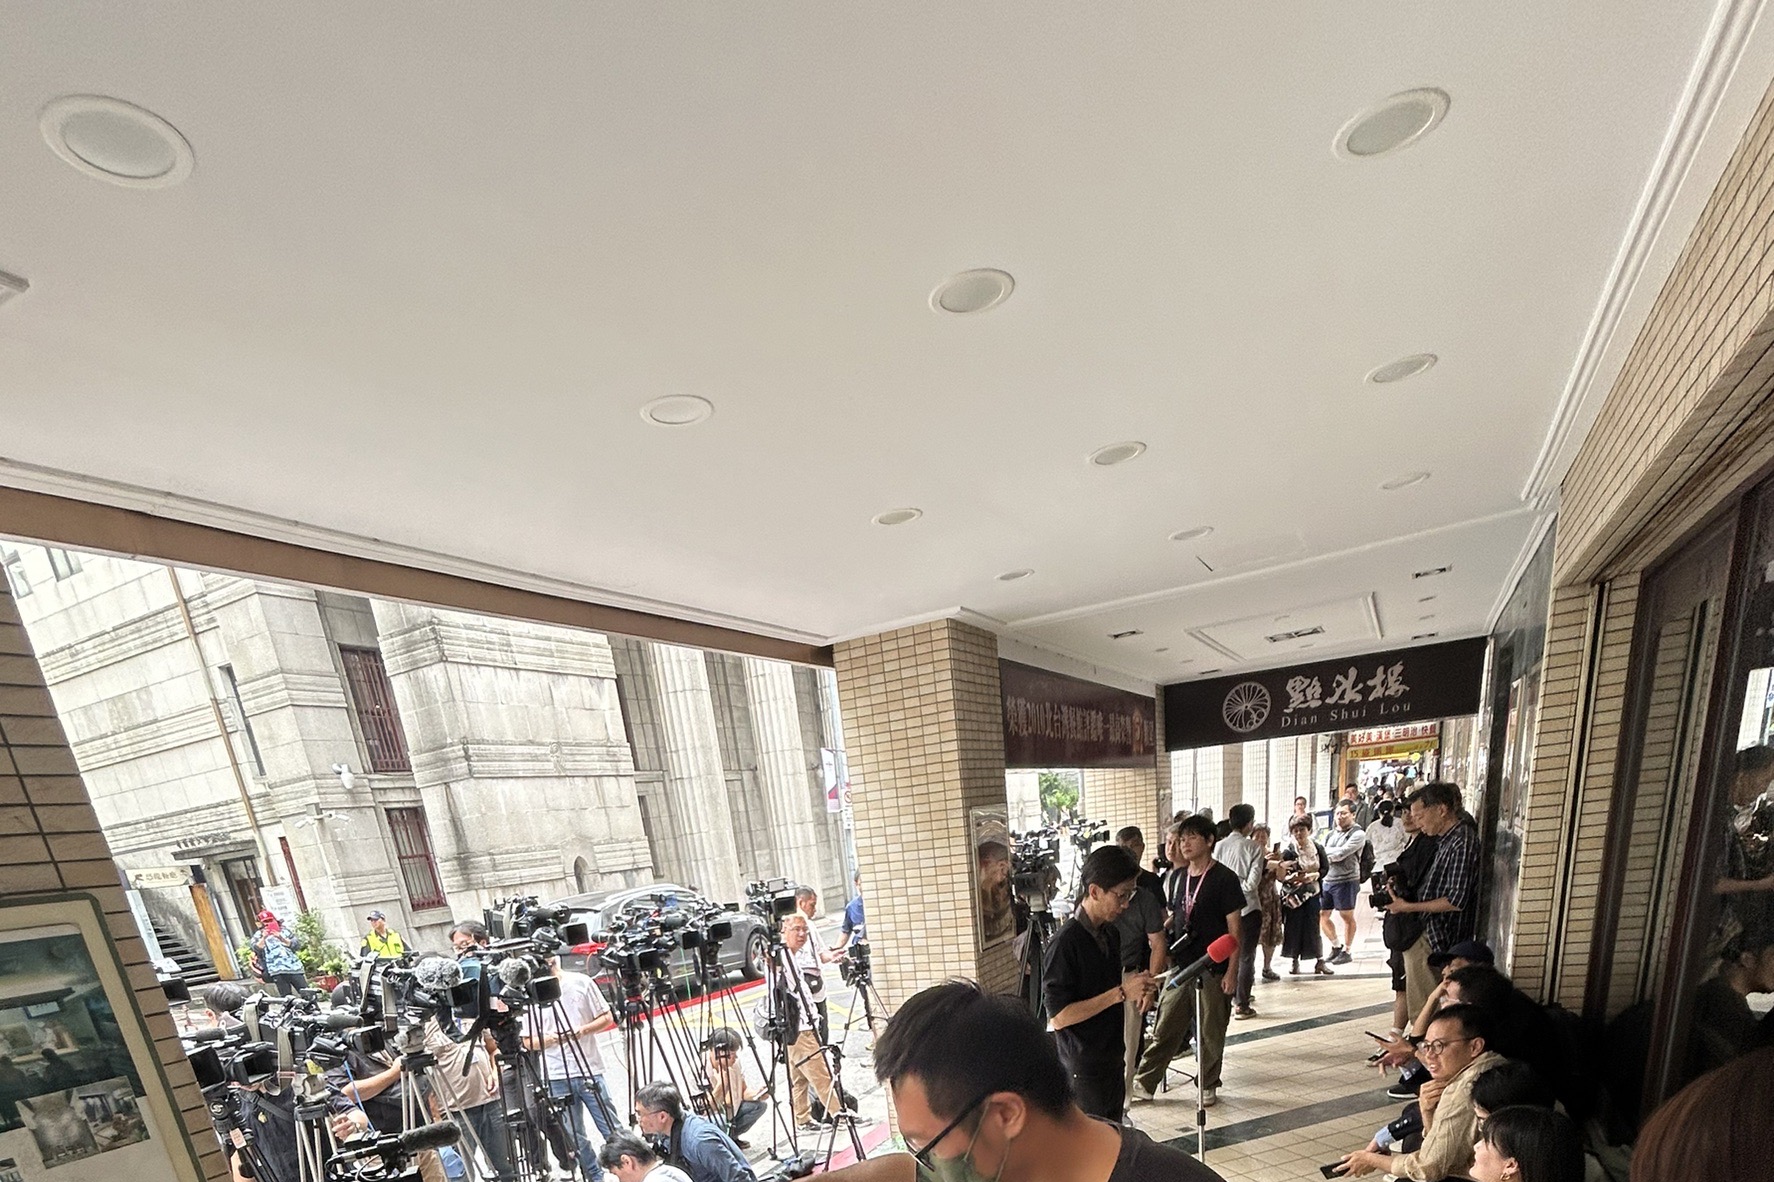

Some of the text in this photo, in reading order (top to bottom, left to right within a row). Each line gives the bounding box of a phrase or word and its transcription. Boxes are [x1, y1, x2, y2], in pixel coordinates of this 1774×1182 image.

[1281, 702, 1411, 728] Dian Shui Lou
